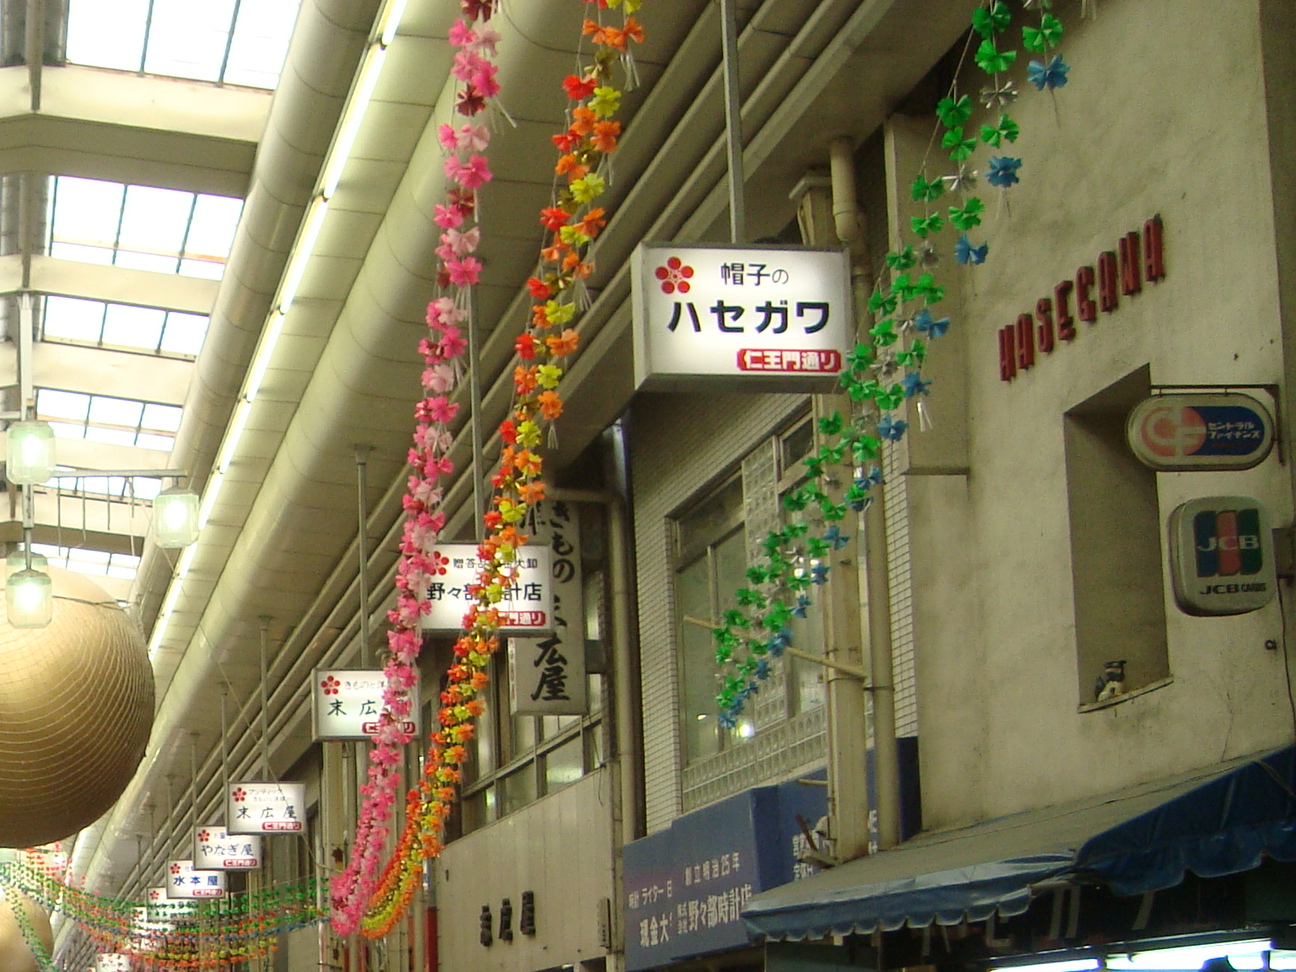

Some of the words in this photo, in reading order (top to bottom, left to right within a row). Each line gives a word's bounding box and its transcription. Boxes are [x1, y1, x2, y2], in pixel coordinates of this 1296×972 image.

[720, 262, 789, 287] 帽子の
[667, 300, 830, 334] ハセガワ
[744, 350, 836, 370] 仁王門通り
[1198, 535, 1260, 551] JCB
[1199, 584, 1240, 594] JCB
[201, 843, 254, 857] やなぎ屋
[173, 875, 219, 887] 水本屋
